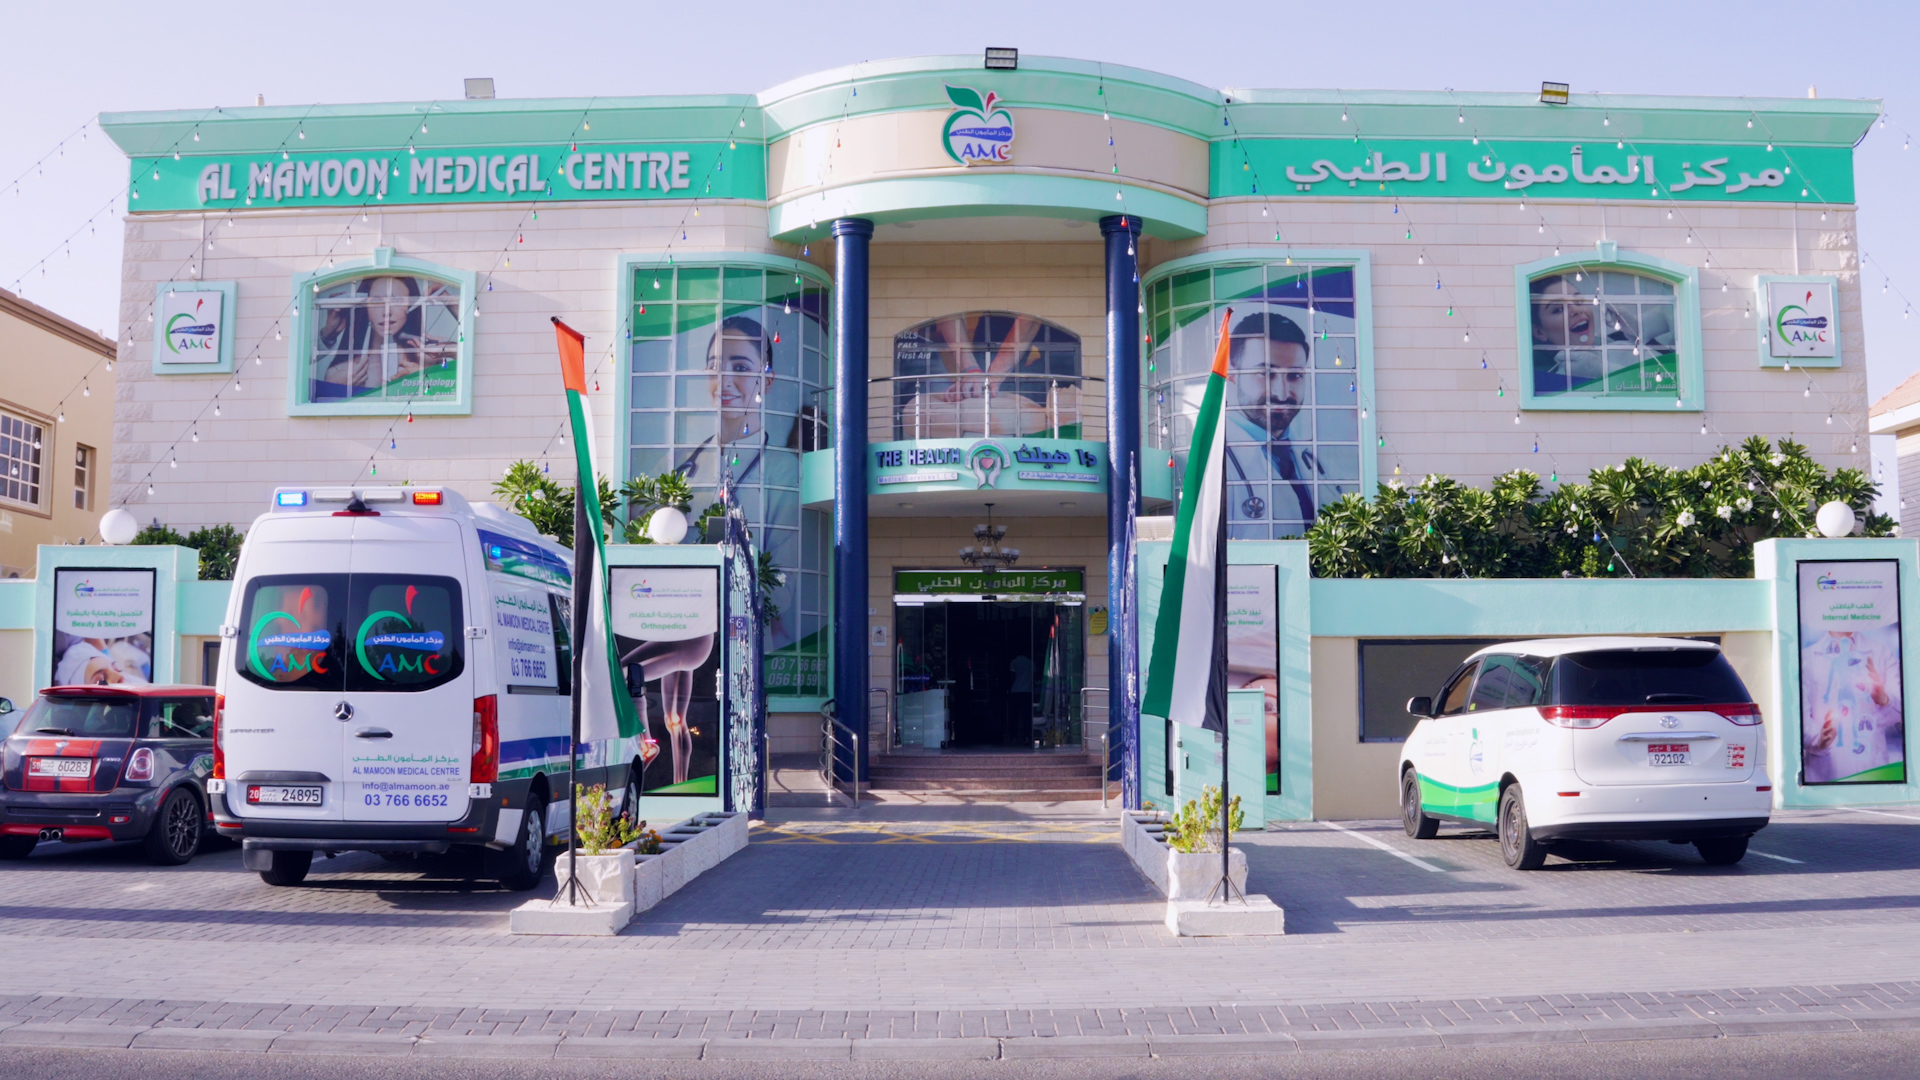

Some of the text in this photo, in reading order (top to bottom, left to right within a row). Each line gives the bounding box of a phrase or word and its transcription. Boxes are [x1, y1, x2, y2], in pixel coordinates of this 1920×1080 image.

[961, 143, 1009, 160] AMC
[1286, 145, 1785, 194] مركز المأمون الطبي
[198, 152, 690, 205] AL MAMOON MEDICAL CENTRE
[1791, 330, 1827, 343] AMC
[178, 338, 213, 350] AMC
[897, 351, 932, 360] First Aid
[401, 378, 456, 388] Cosmetology
[1656, 383, 1677, 394] قسم
[875, 450, 902, 468] THE
[908, 447, 960, 465] HEALTH
[1013, 443, 1071, 469] هيلث
[918, 577, 961, 591] الطبي
[1031, 576, 1067, 589] مركز
[1850, 613, 1882, 621] Medicine
[71, 620, 96, 629] Beauty
[104, 620, 119, 628] Skin
[120, 620, 137, 628] Care
[641, 622, 688, 631] Orthopedics
[264, 634, 330, 645] مركز المأمون الطبي
[373, 635, 395, 645] الطبي
[269, 651, 329, 674] AMC
[378, 652, 441, 675] AMC
[511, 657, 547, 679] 03 766 6652
[771, 657, 786, 671] 03
[768, 673, 790, 686] 056
[1666, 744, 1672, 752] 8
[393, 753, 433, 763] المأمون
[434, 755, 459, 765] مركز
[1654, 753, 1685, 764] 92102
[57, 761, 88, 772] 60283
[352, 766, 460, 775] AL MAMOON MEDICAL CENTRE
[362, 782, 450, 792] info@almamoon.ae
[248, 789, 260, 799] 20
[281, 788, 320, 802] 24895
[364, 794, 448, 807] 03 766 6652
